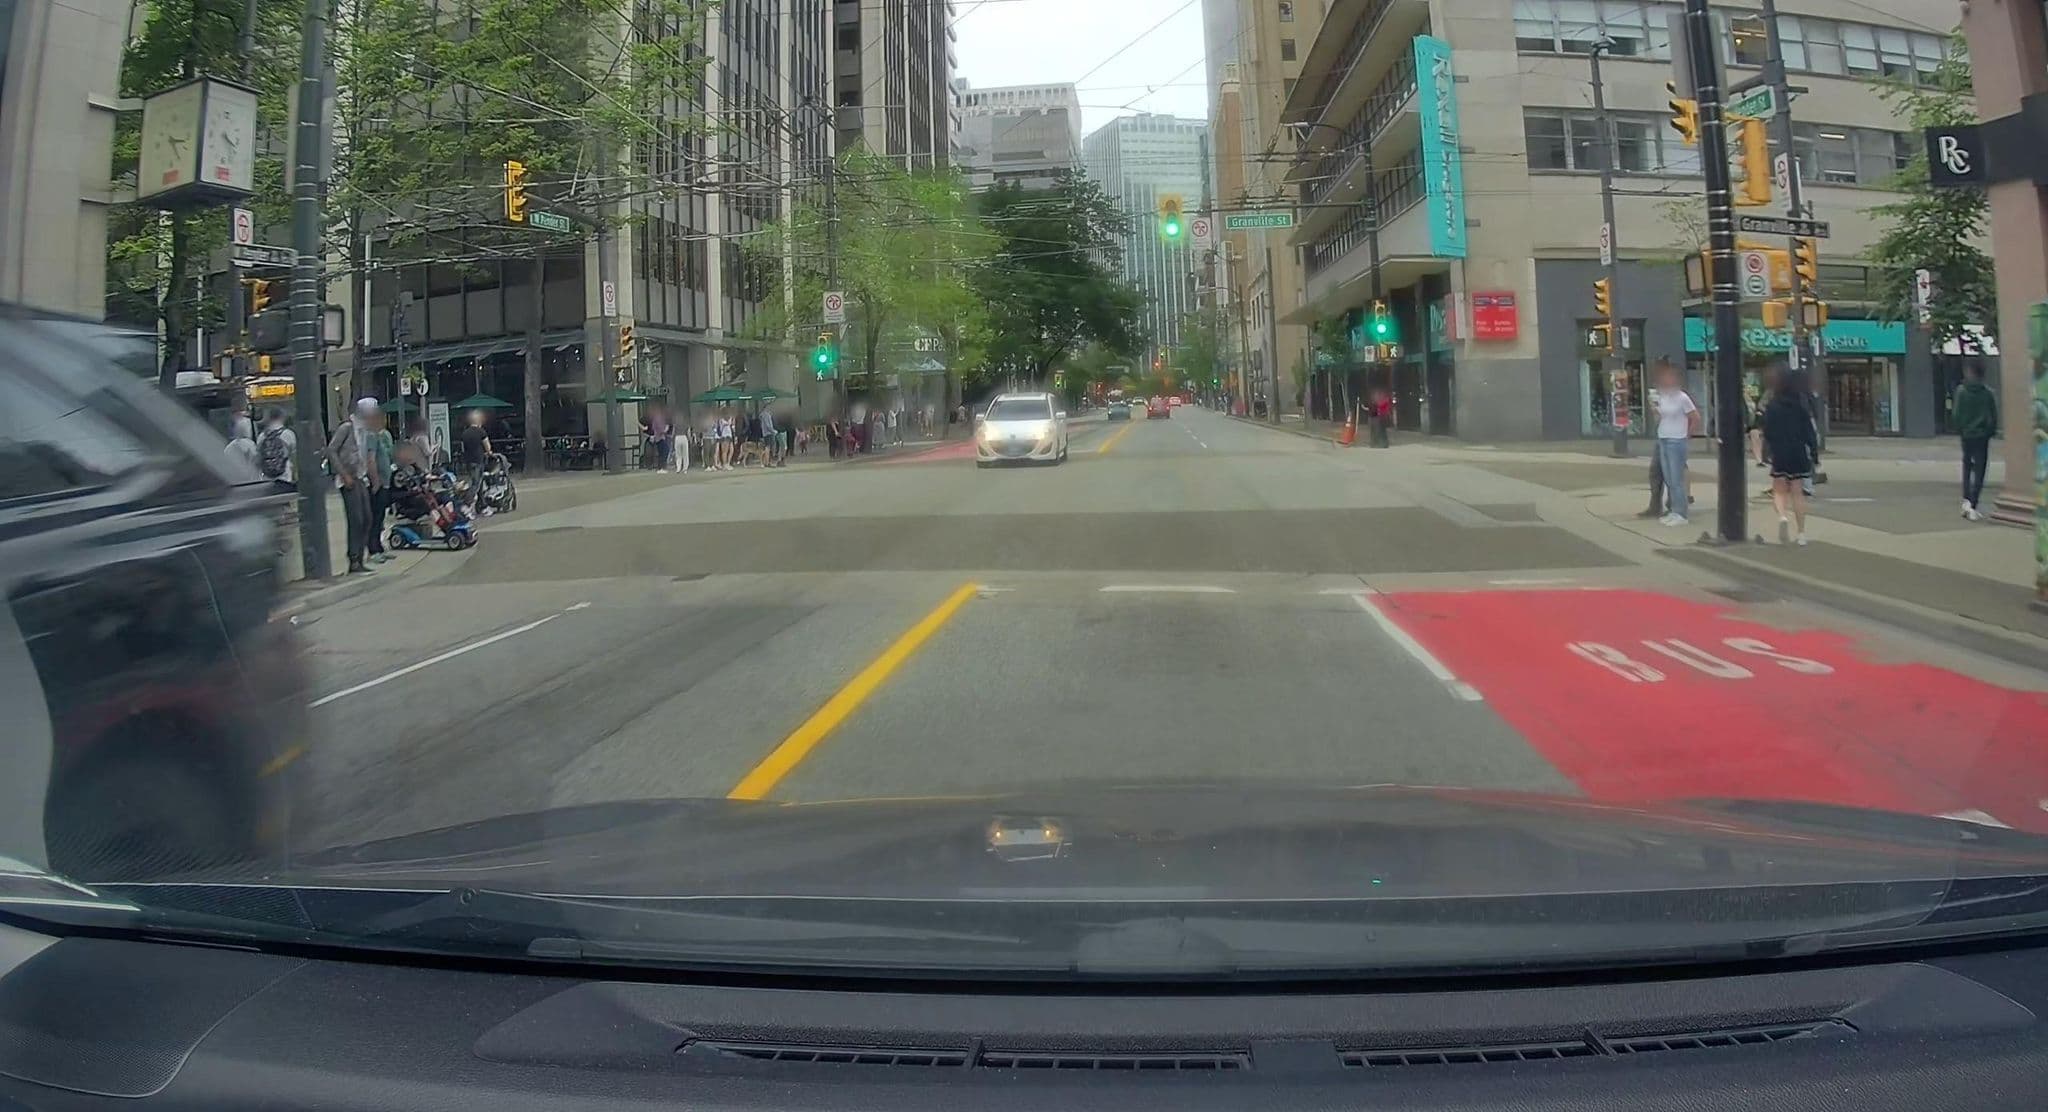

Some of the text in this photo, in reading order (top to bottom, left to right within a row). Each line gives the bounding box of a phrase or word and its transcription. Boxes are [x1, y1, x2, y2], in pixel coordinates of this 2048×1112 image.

[1232, 215, 1287, 227] Granville St
[1742, 217, 1796, 235] Granville
[1565, 637, 1835, 682] BUS
